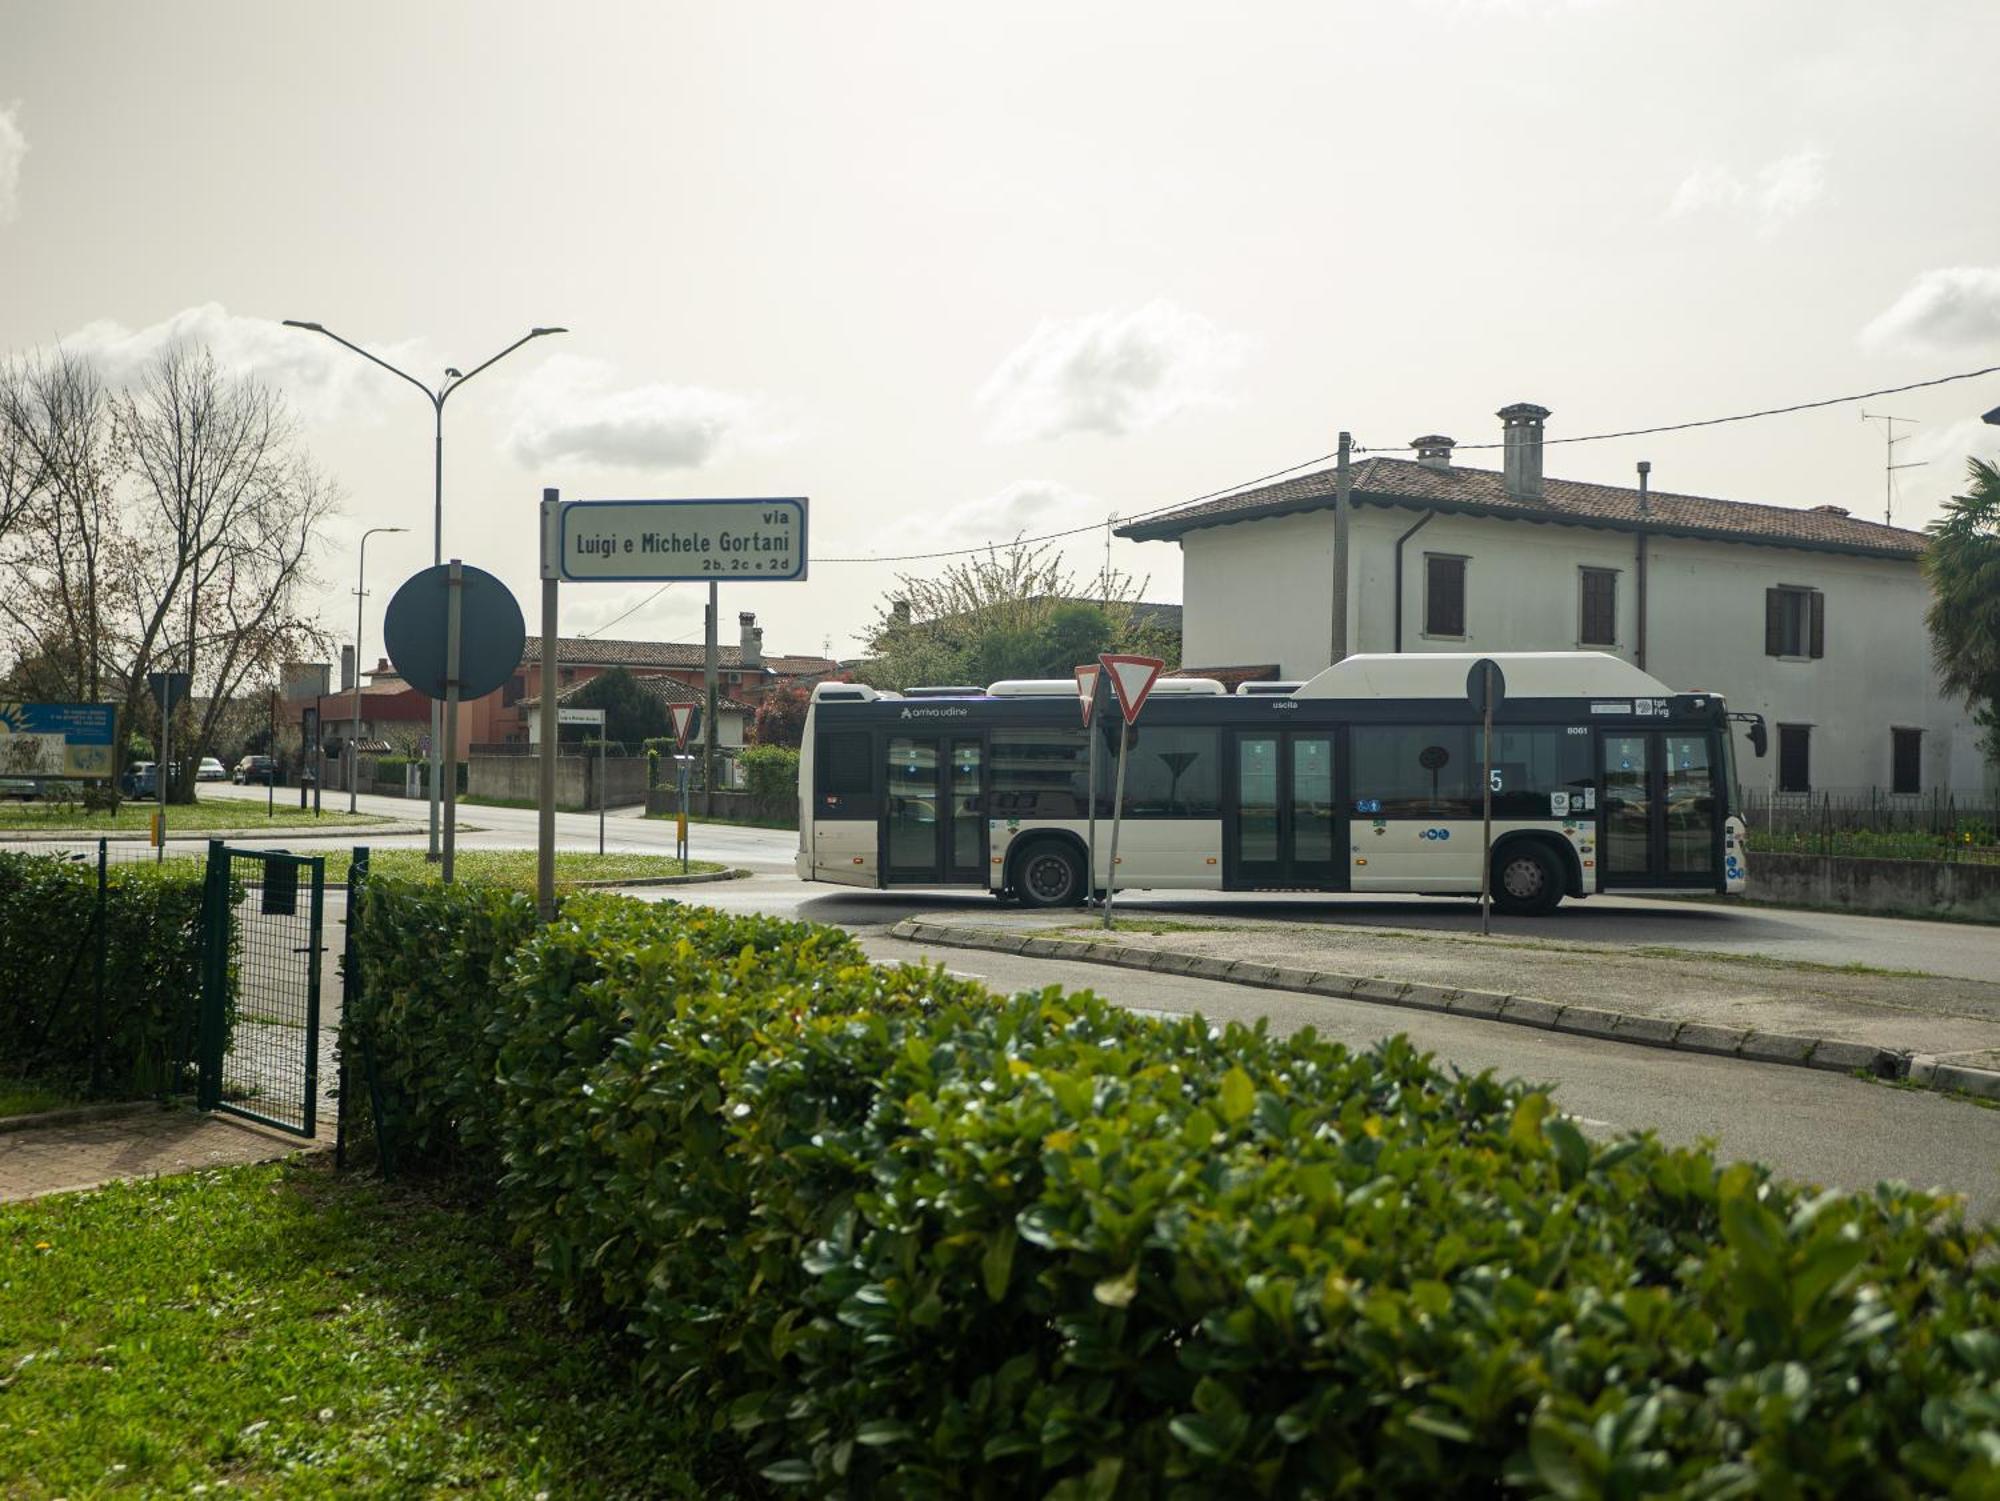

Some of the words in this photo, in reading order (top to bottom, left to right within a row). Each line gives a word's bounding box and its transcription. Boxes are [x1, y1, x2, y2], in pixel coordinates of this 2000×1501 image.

[763, 510, 790, 524] via
[577, 534, 617, 558] Luigi
[623, 541, 634, 553] e
[641, 532, 711, 553] Michele
[719, 531, 790, 553] Gortani
[703, 559, 726, 572] 2b,
[731, 559, 749, 570] 2c
[755, 562, 763, 570] e
[769, 559, 790, 570] 2d
[1490, 769, 1502, 791] 5
